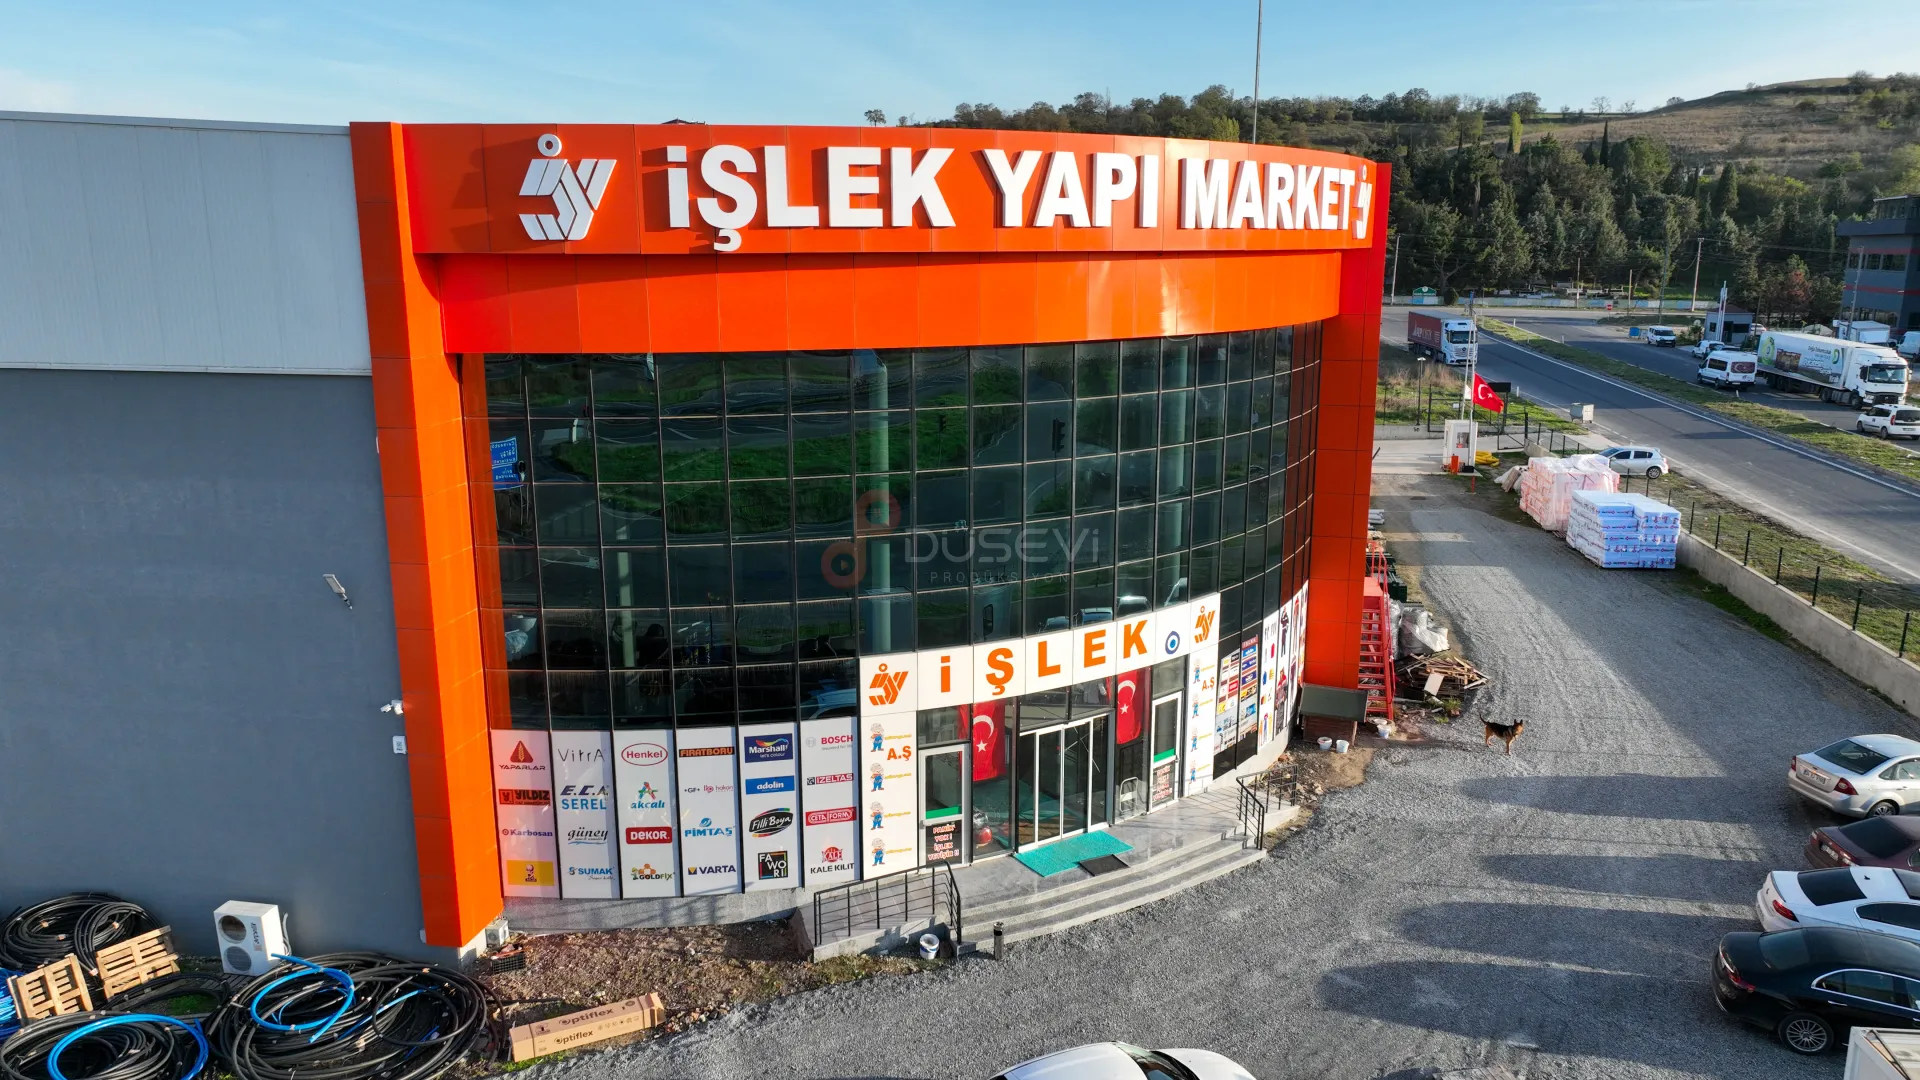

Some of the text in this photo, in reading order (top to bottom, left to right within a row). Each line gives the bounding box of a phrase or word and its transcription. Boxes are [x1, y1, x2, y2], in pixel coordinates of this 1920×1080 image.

[981, 148, 1159, 228] YAPI
[1178, 157, 1356, 230] MARKET
[821, 734, 853, 745] BOSCH
[557, 748, 606, 762] VitrA
[626, 749, 663, 759] Henkel
[748, 744, 786, 755] Marshall
[756, 780, 785, 790] adolin
[561, 798, 607, 810] SEREL
[769, 814, 792, 828] Boya
[510, 828, 554, 837] Karbosan
[567, 826, 609, 841] güney
[578, 867, 613, 875] SUMAK
[699, 864, 737, 875] VARTA
[810, 865, 833, 875] KALE
